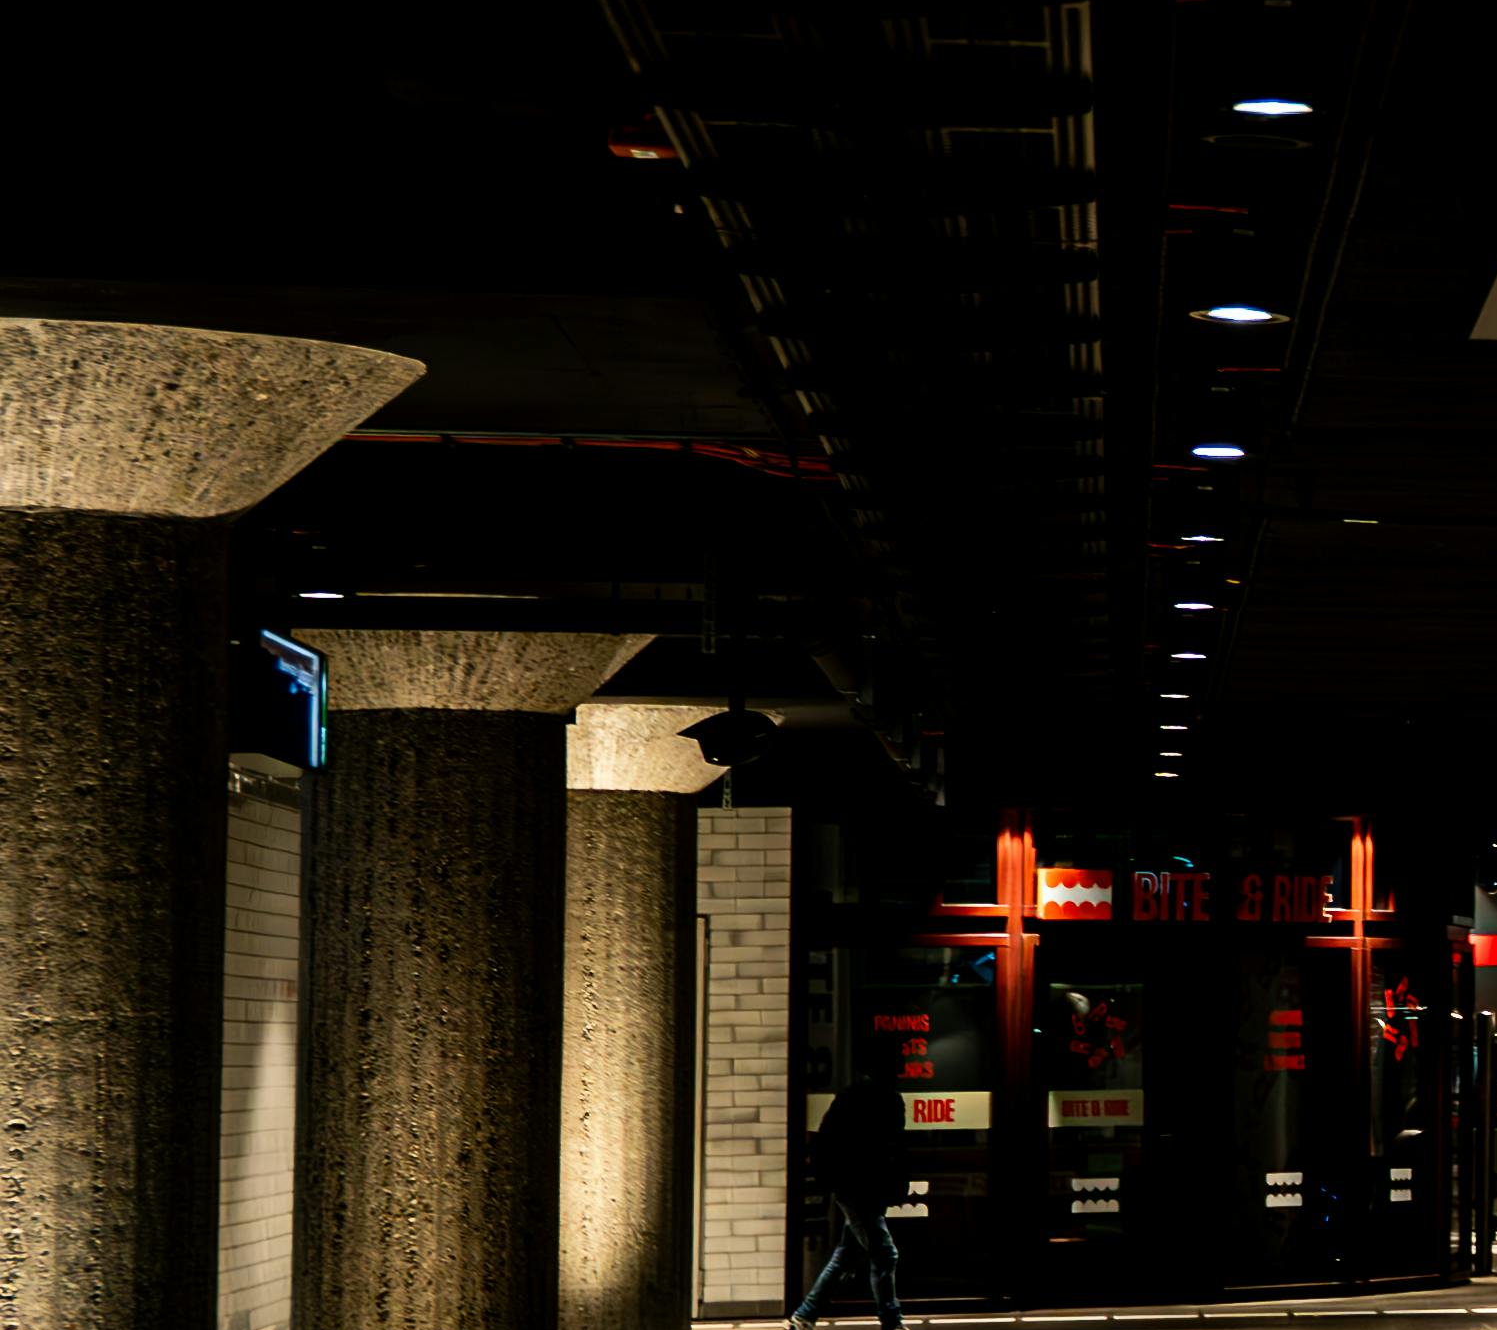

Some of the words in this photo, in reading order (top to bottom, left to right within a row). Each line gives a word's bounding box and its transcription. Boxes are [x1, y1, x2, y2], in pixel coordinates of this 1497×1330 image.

[1132, 870, 1211, 921] BITE
[1236, 872, 1266, 922] &
[1270, 873, 1336, 924] RIDE
[912, 1098, 956, 1124] RIDE
